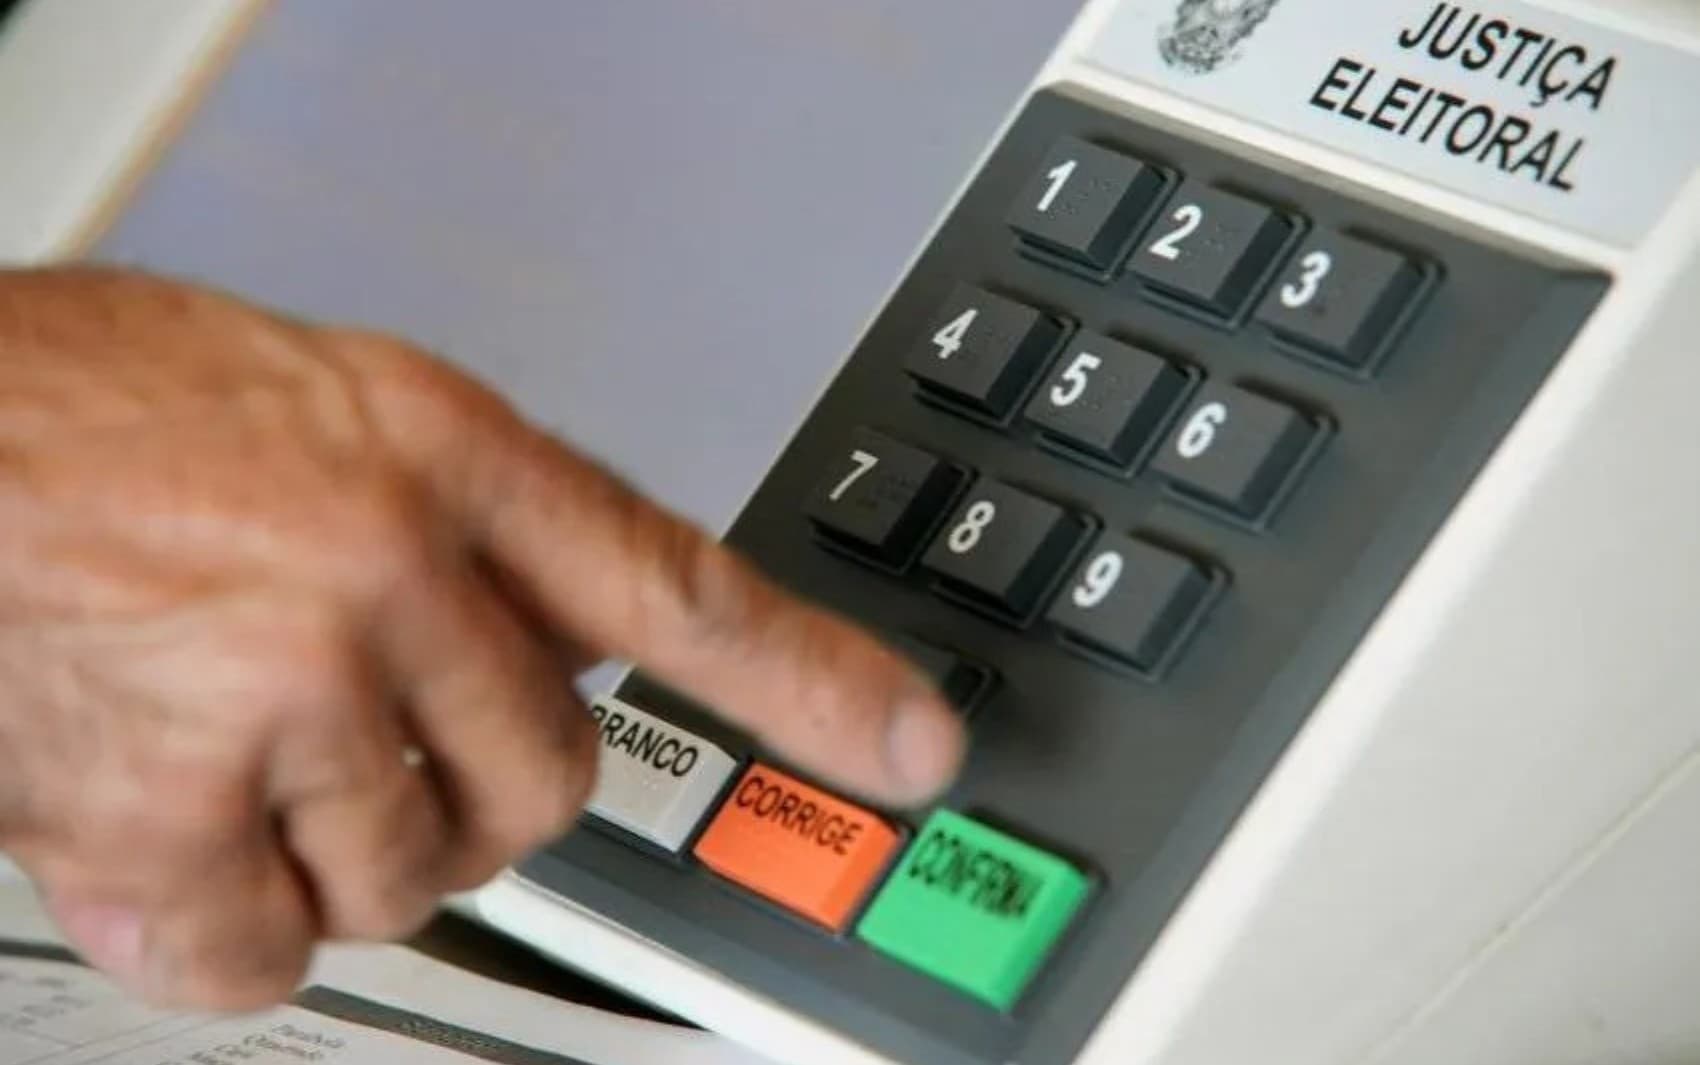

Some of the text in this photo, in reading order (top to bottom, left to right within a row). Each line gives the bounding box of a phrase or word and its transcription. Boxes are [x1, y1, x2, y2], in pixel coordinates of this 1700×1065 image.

[1399, 2, 1617, 110] JUSTIÇA
[1309, 57, 1586, 192] ELEITORAL
[1036, 159, 1077, 212] 1
[1149, 204, 1202, 260] 2
[1280, 251, 1331, 308] 3
[932, 309, 977, 359] 4
[1050, 352, 1101, 406] 5
[1176, 402, 1227, 458] 6
[829, 450, 879, 500] 7
[948, 501, 995, 553] 8
[1072, 551, 1123, 608] 9
[735, 775, 865, 856] CORRIGE
